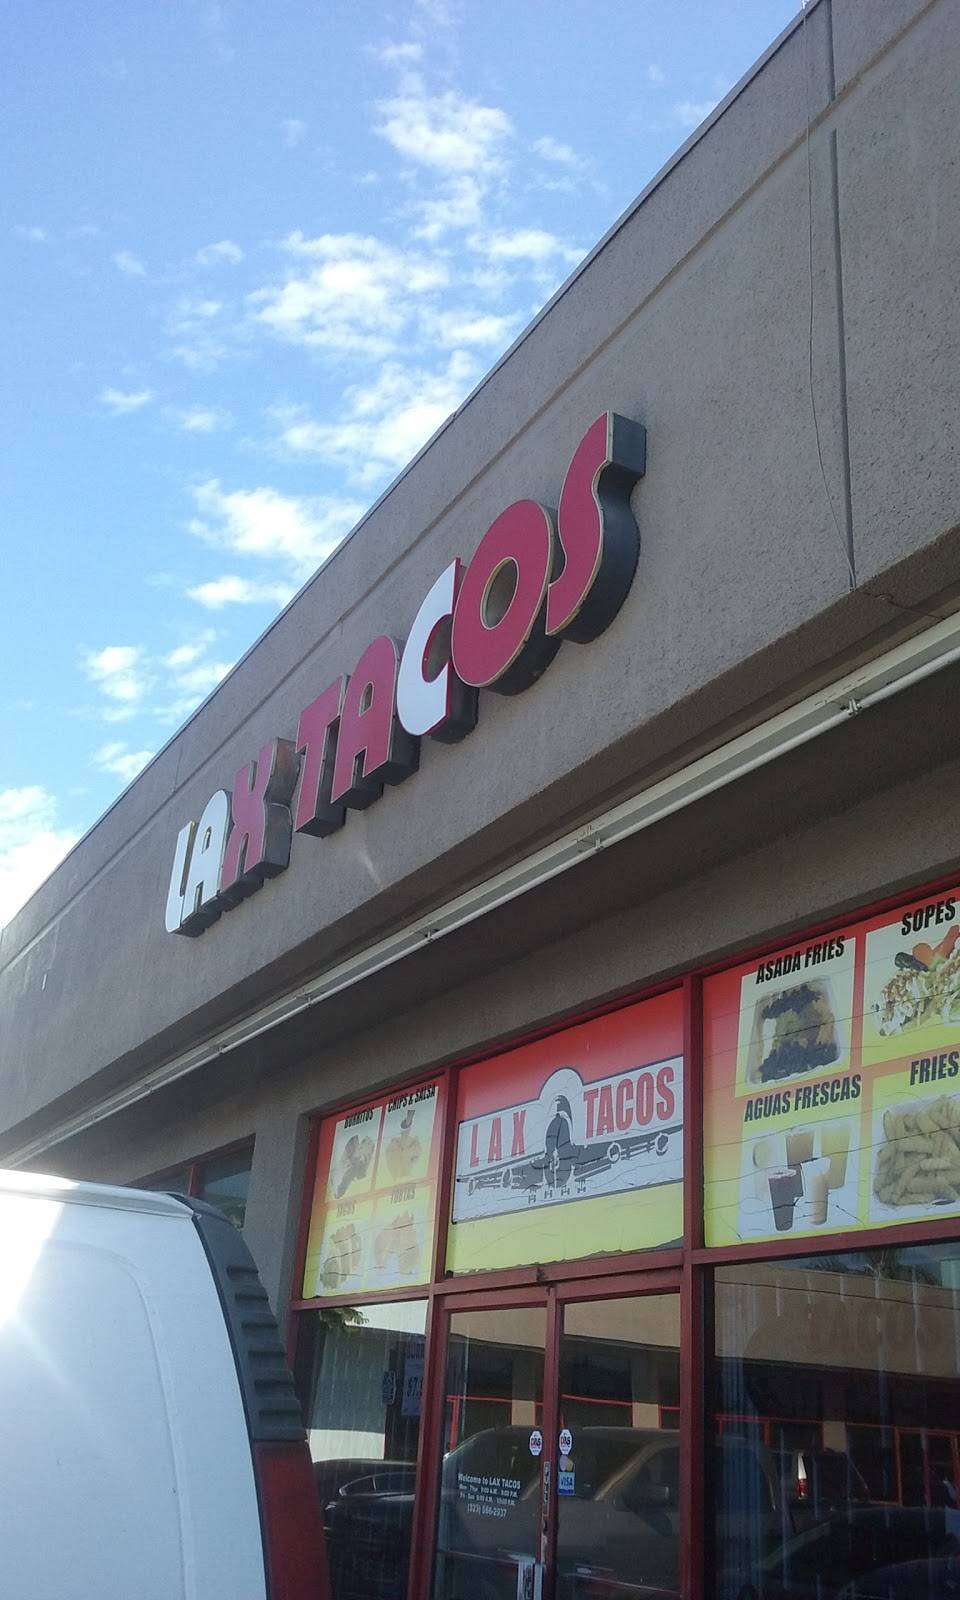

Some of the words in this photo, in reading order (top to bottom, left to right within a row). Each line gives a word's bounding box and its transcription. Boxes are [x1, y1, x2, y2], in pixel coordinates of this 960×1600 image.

[165, 738, 290, 936] LAX
[295, 410, 632, 836] TACOS
[901, 896, 956, 936] SOPES
[756, 949, 801, 985] ASADA
[804, 935, 846, 969] FRIES
[910, 1051, 960, 1086] FRIES
[415, 1083, 437, 1103] SALSA
[744, 1090, 791, 1123] AGUAS
[794, 1074, 862, 1112] FRESCAS
[344, 1106, 375, 1129] BURRITOS
[469, 1109, 527, 1169] LAX
[583, 1066, 675, 1139] TACOS
[458, 1473, 481, 1484] Welcome
[489, 1477, 500, 1487] LAX
[502, 1478, 521, 1490] TACOS
[561, 1476, 573, 1487] VISA
